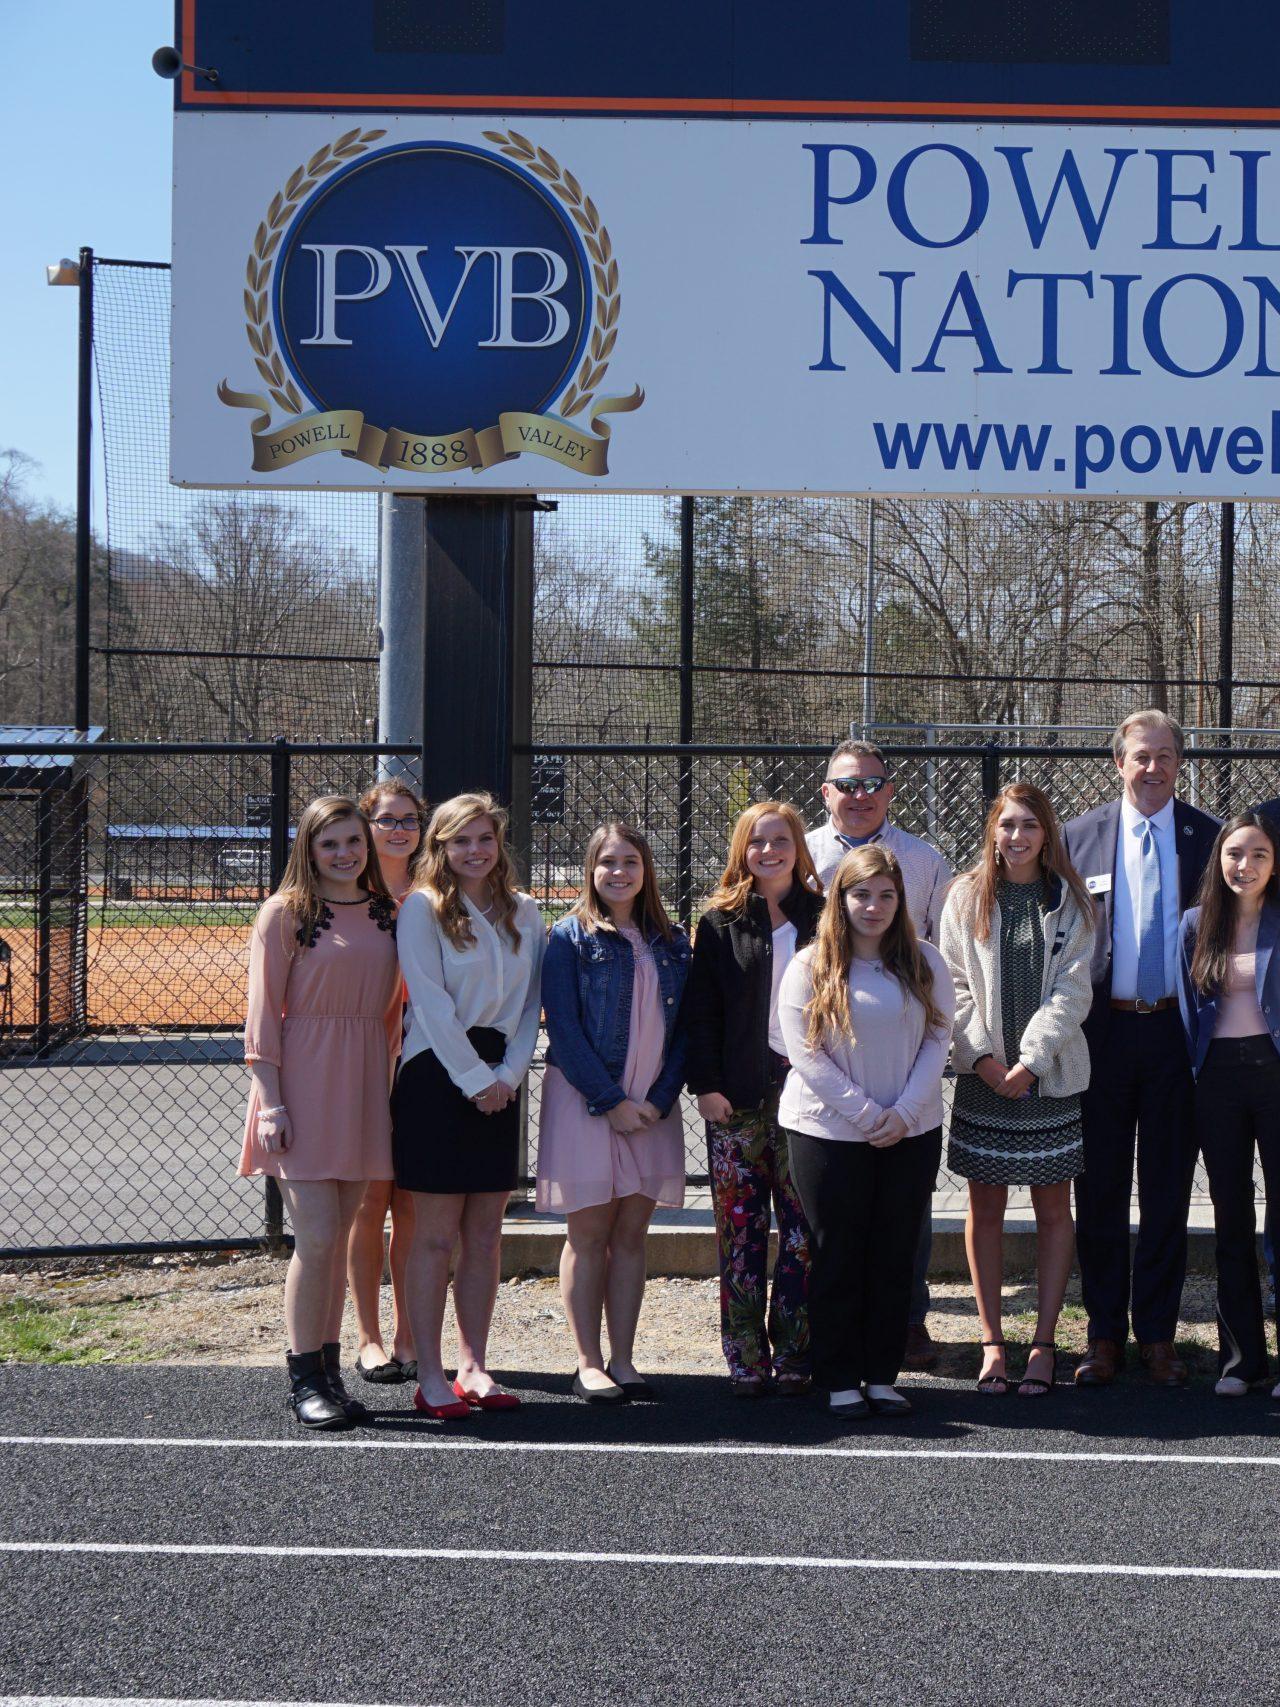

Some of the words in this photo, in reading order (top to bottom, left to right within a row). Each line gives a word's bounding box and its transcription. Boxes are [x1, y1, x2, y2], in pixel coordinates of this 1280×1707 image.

[300, 244, 571, 348] PVB
[269, 424, 351, 460] POWELL
[397, 439, 469, 467] 1888
[517, 426, 592, 462] VALLEY
